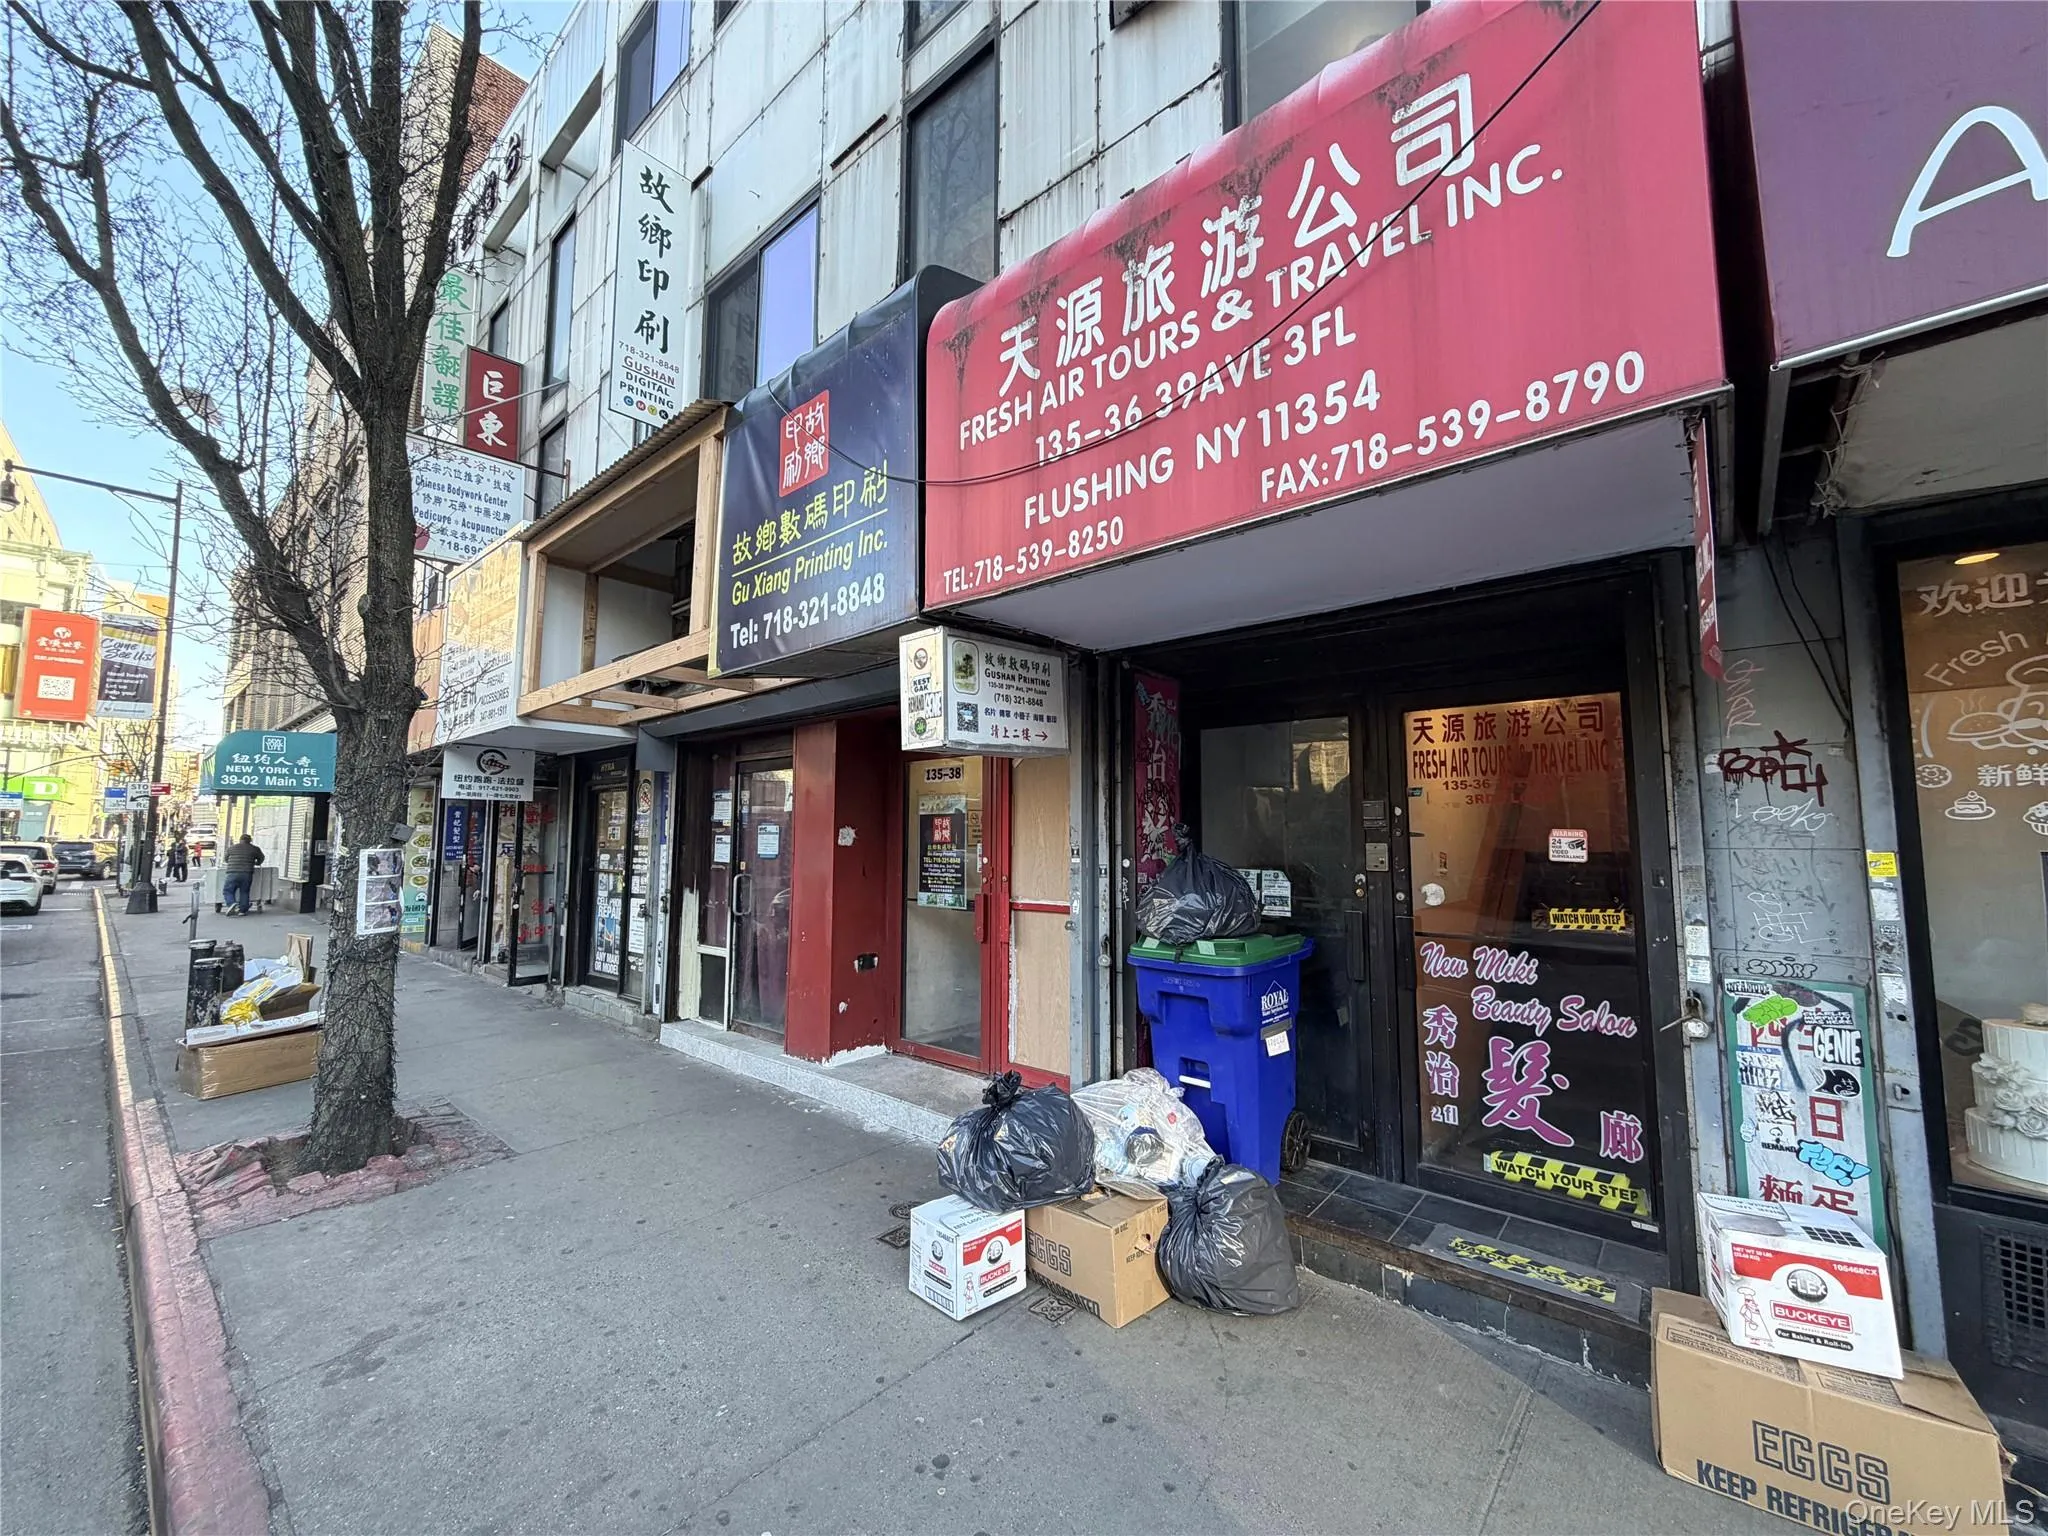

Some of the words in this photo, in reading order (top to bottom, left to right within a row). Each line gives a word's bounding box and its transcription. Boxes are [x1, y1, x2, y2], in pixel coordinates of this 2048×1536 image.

[998, 72, 1476, 397] 天源旅游公司
[959, 388, 1034, 451] FRESH
[1039, 369, 1085, 417] AIR
[1090, 320, 1201, 388] TOURS
[1211, 290, 1253, 332] &
[1264, 201, 1431, 309] TRAVEL
[1447, 143, 1565, 229] INC.
[618, 340, 680, 375] 718-321-8848
[623, 355, 676, 386] GUSHAN
[1155, 336, 1273, 419] 39AVE
[1282, 303, 1357, 368] 3FL
[619, 381, 674, 410] PRINTING
[624, 371, 671, 397] DIGITAL
[475, 370, 508, 447] 巨東
[1023, 443, 1175, 529] FLUSHING
[1195, 417, 1247, 471] NY
[1256, 369, 1382, 449] 11354
[415, 475, 446, 493] Chinese
[446, 482, 483, 502] Bodywork
[484, 493, 508, 509] Center
[413, 505, 453, 526] Pedicure
[731, 579, 750, 606] Gu
[752, 567, 791, 600] Xiang
[794, 540, 854, 583] Printing
[858, 528, 888, 565] Inc.
[731, 620, 758, 649] Tel:
[763, 572, 886, 641] 718-321-8848
[101, 637, 138, 651] Come
[104, 648, 133, 660] See
[1923, 630, 2030, 687] Fresh
[984, 667, 1016, 682] GUSHAN
[1017, 673, 1051, 688] PRINTING
[994, 692, 1012, 705] (718)
[1013, 695, 1044, 707] 321-8848
[1411, 700, 1604, 746] 天源旅游公司
[225, 765, 254, 773] NEW
[258, 766, 289, 775] YORK
[294, 768, 317, 776] LIFE
[925, 767, 961, 780] 135-38
[1412, 750, 1448, 780] FRESH
[1450, 748, 1470, 778] AIR
[1472, 744, 1514, 777] TOURS
[1533, 740, 1582, 774] TRAVEL
[220, 775, 259, 786] 39-02
[265, 776, 297, 787] Main
[302, 777, 323, 787] ST.
[1442, 779, 1491, 791] 135-36
[1552, 830, 1584, 838] WARNING
[1552, 913, 1579, 925] WATCH
[1580, 913, 1600, 925] YOUR
[1601, 913, 1622, 925] STEP
[1420, 941, 1469, 979] New
[1472, 945, 1538, 986] Miki
[1261, 988, 1290, 1011] ROYAL
[1471, 985, 1552, 1036] Beauty
[1556, 994, 1638, 1039] Salon
[1422, 1004, 1460, 1099] 秀治
[1812, 1026, 1862, 1067] GENIE
[1495, 1159, 1546, 1182] WATCH
[1550, 1171, 1594, 1193] YOUR
[1598, 1184, 1638, 1202] STEP
[1026, 1228, 1072, 1277] EGGS
[1454, 1241, 1508, 1263] WATCH
[980, 1262, 1010, 1284] BUCKEYE
[1787, 1278, 1828, 1296] FLEX
[1774, 1306, 1850, 1329] BUCKEYE
[1777, 1329, 1792, 1338] For
[1792, 1331, 1816, 1344] Baking
[1751, 1420, 1891, 1505] EGGS
[1696, 1459, 1757, 1501] KEEP
